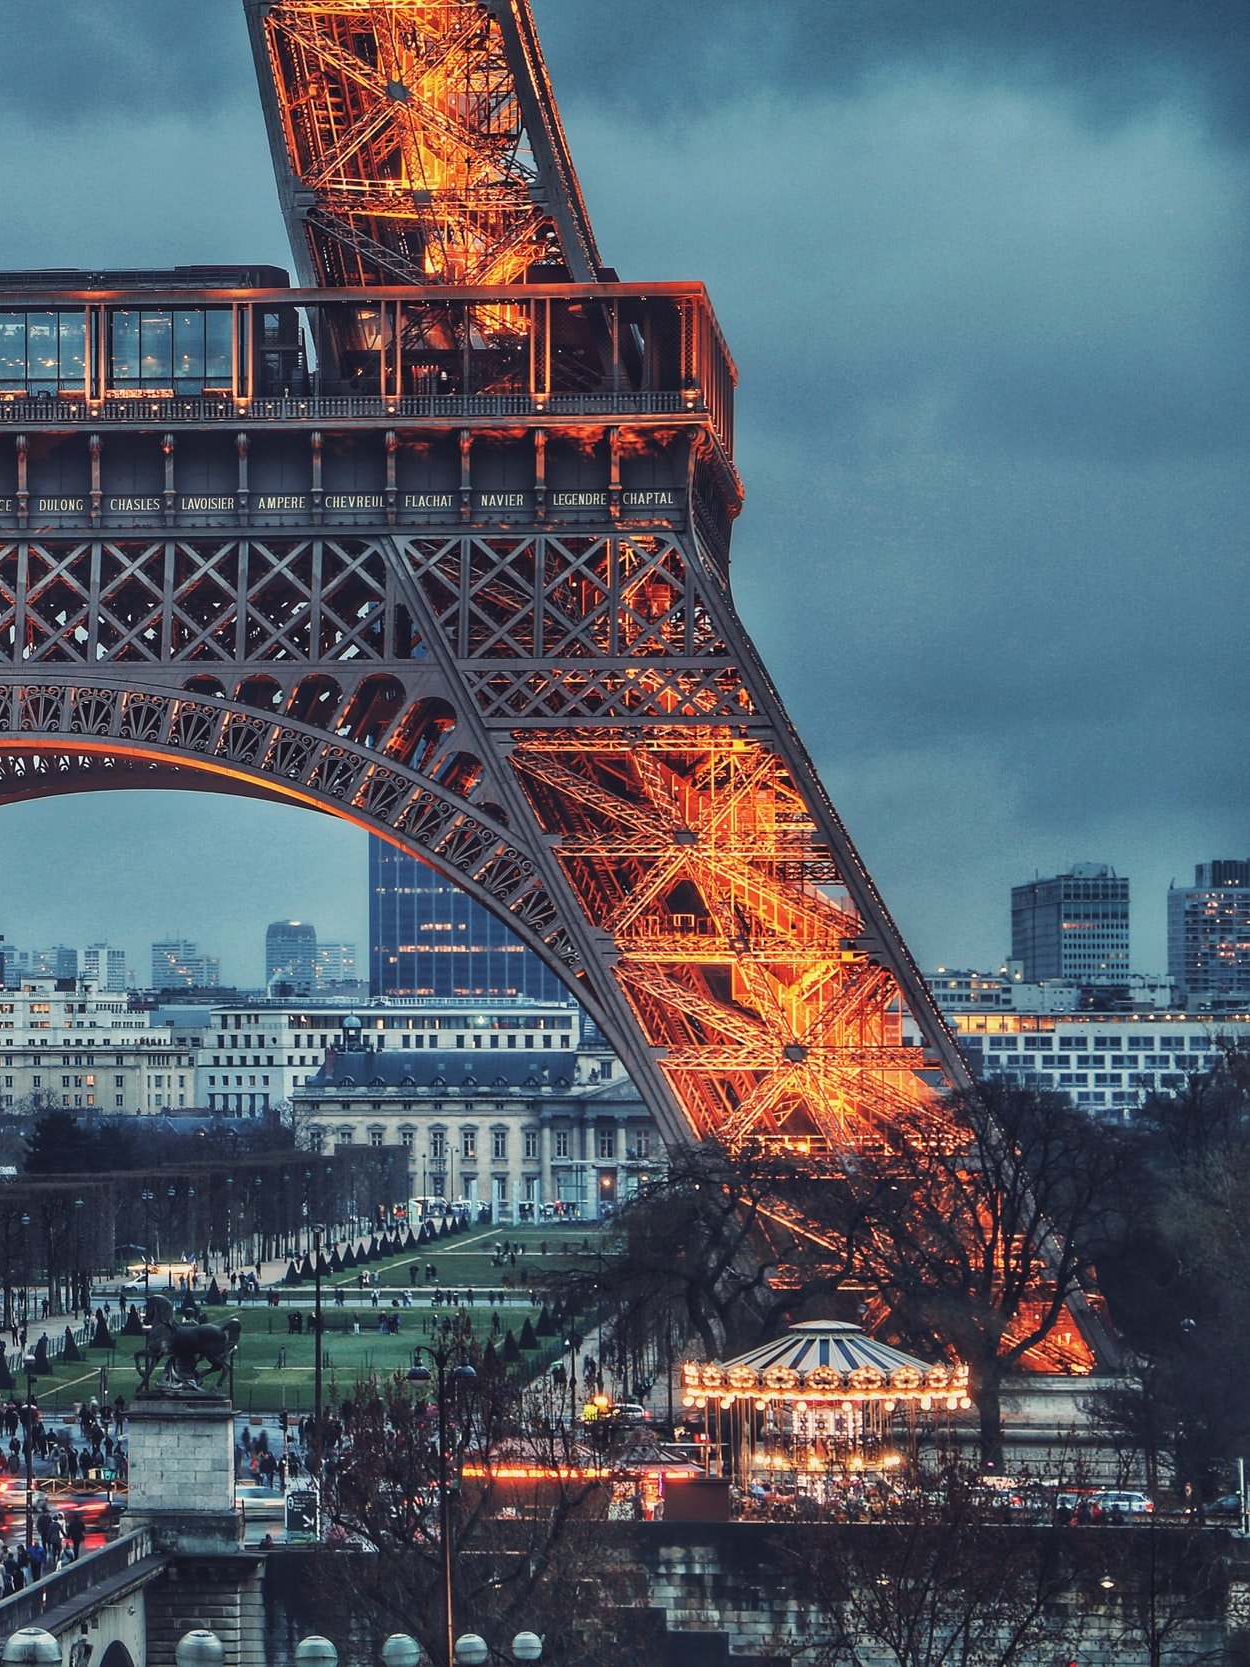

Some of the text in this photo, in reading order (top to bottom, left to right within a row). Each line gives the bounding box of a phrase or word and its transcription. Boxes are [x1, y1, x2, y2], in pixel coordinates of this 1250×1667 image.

[110, 498, 160, 511] CHASLES
[181, 497, 235, 510] LAVOISIER
[258, 496, 306, 509] AMPERE
[325, 495, 385, 508] CHEVREUL
[405, 495, 452, 508] FLACHAT
[481, 494, 524, 507] NAVIER
[553, 493, 607, 506] LEGENDRE
[622, 492, 674, 505] CHAPTAL
[39, 499, 83, 512] DULONG
